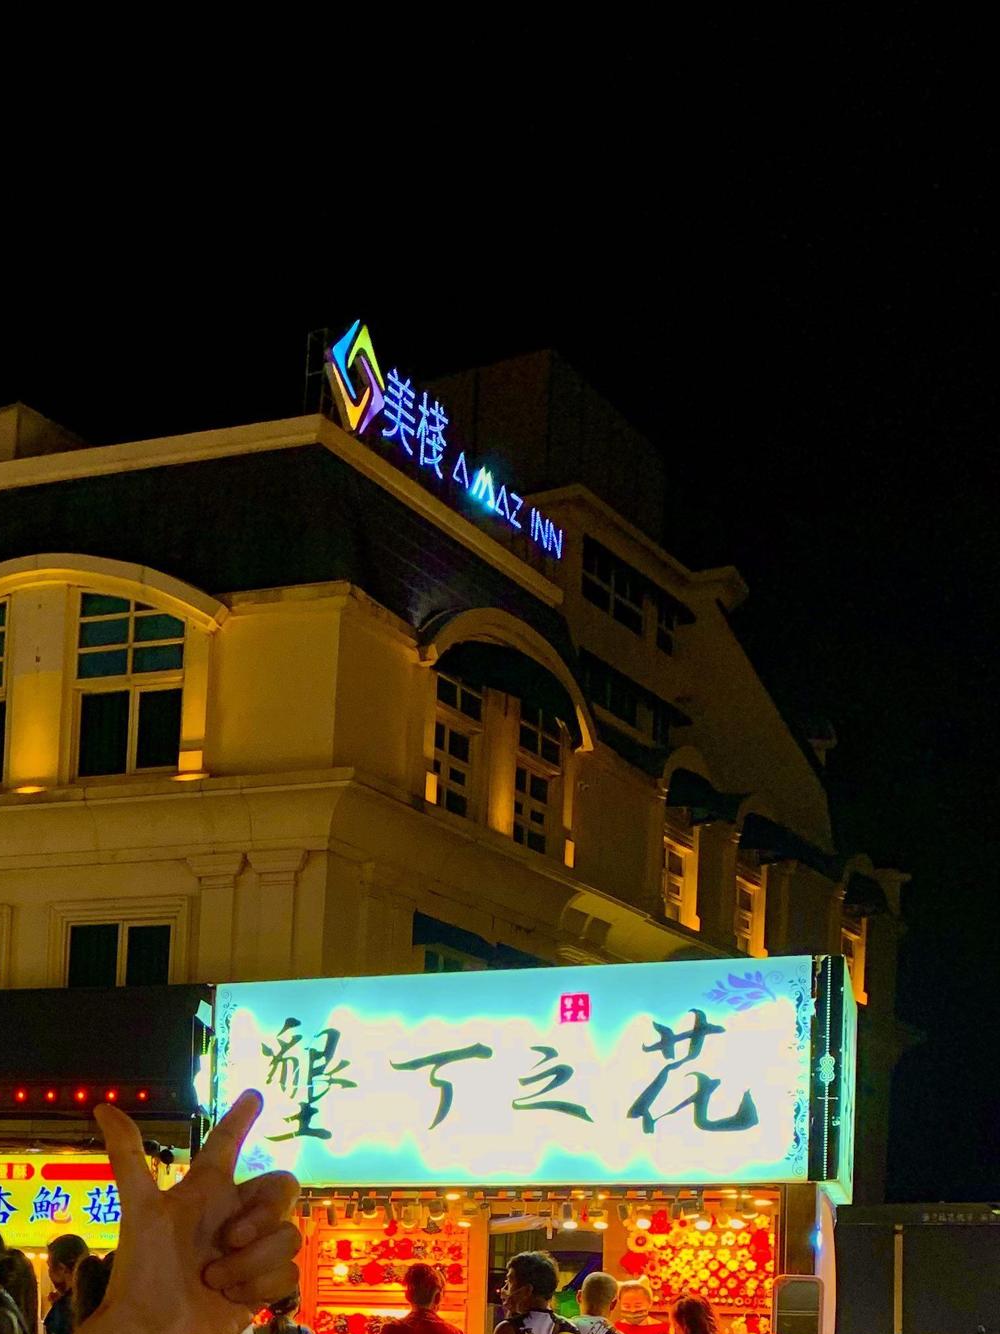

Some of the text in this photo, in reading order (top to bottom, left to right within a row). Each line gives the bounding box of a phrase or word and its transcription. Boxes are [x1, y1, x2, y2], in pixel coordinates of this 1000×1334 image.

[381, 367, 449, 480] 美棧
[530, 506, 564, 560] INN
[260, 1008, 759, 1142] 墾丁之花
